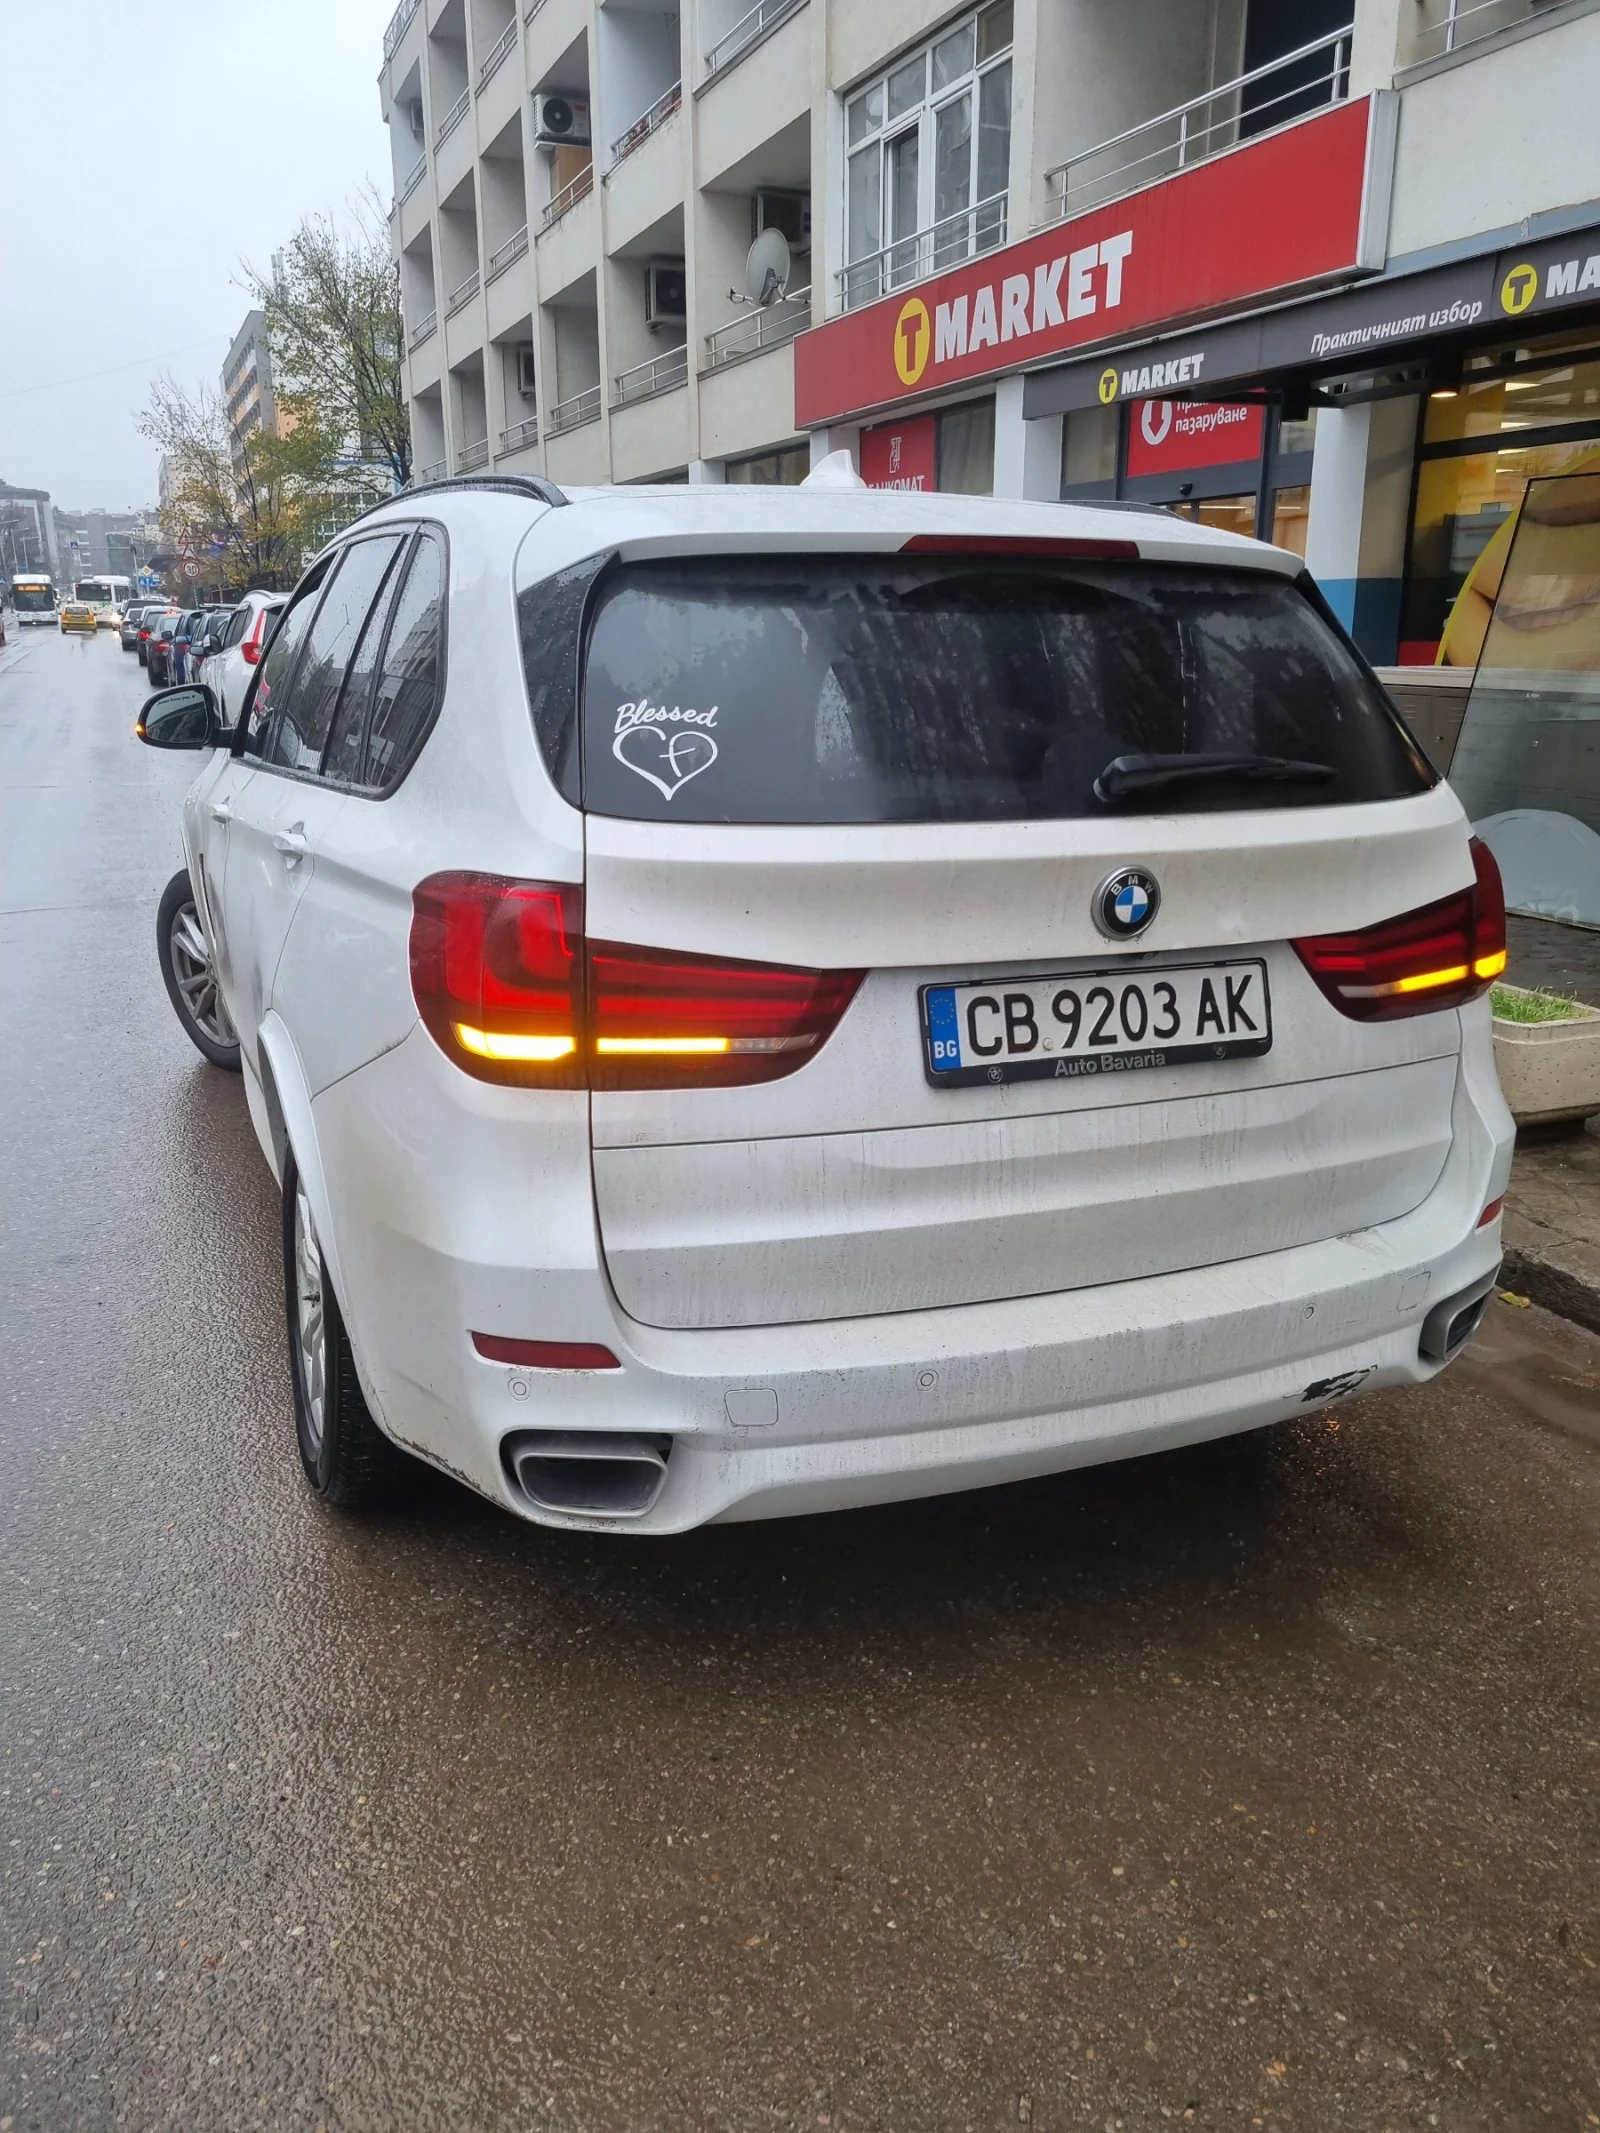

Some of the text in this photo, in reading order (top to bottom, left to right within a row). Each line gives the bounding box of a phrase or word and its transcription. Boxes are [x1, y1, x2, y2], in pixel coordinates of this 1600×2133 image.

[1545, 254, 1600, 299] MA
[934, 230, 1133, 364] MARKET
[1310, 300, 1483, 355] Практичният избор
[1121, 353, 1204, 395] MARKET
[1175, 406, 1247, 435] пазаруване
[186, 566, 196, 575] 30
[614, 699, 719, 733] Blessed
[1110, 875, 1154, 896] BMW
[966, 975, 1258, 1056] CB 9203 AK
[934, 1040, 958, 1059] BG
[1055, 1050, 1166, 1077] Auto Bavaria
